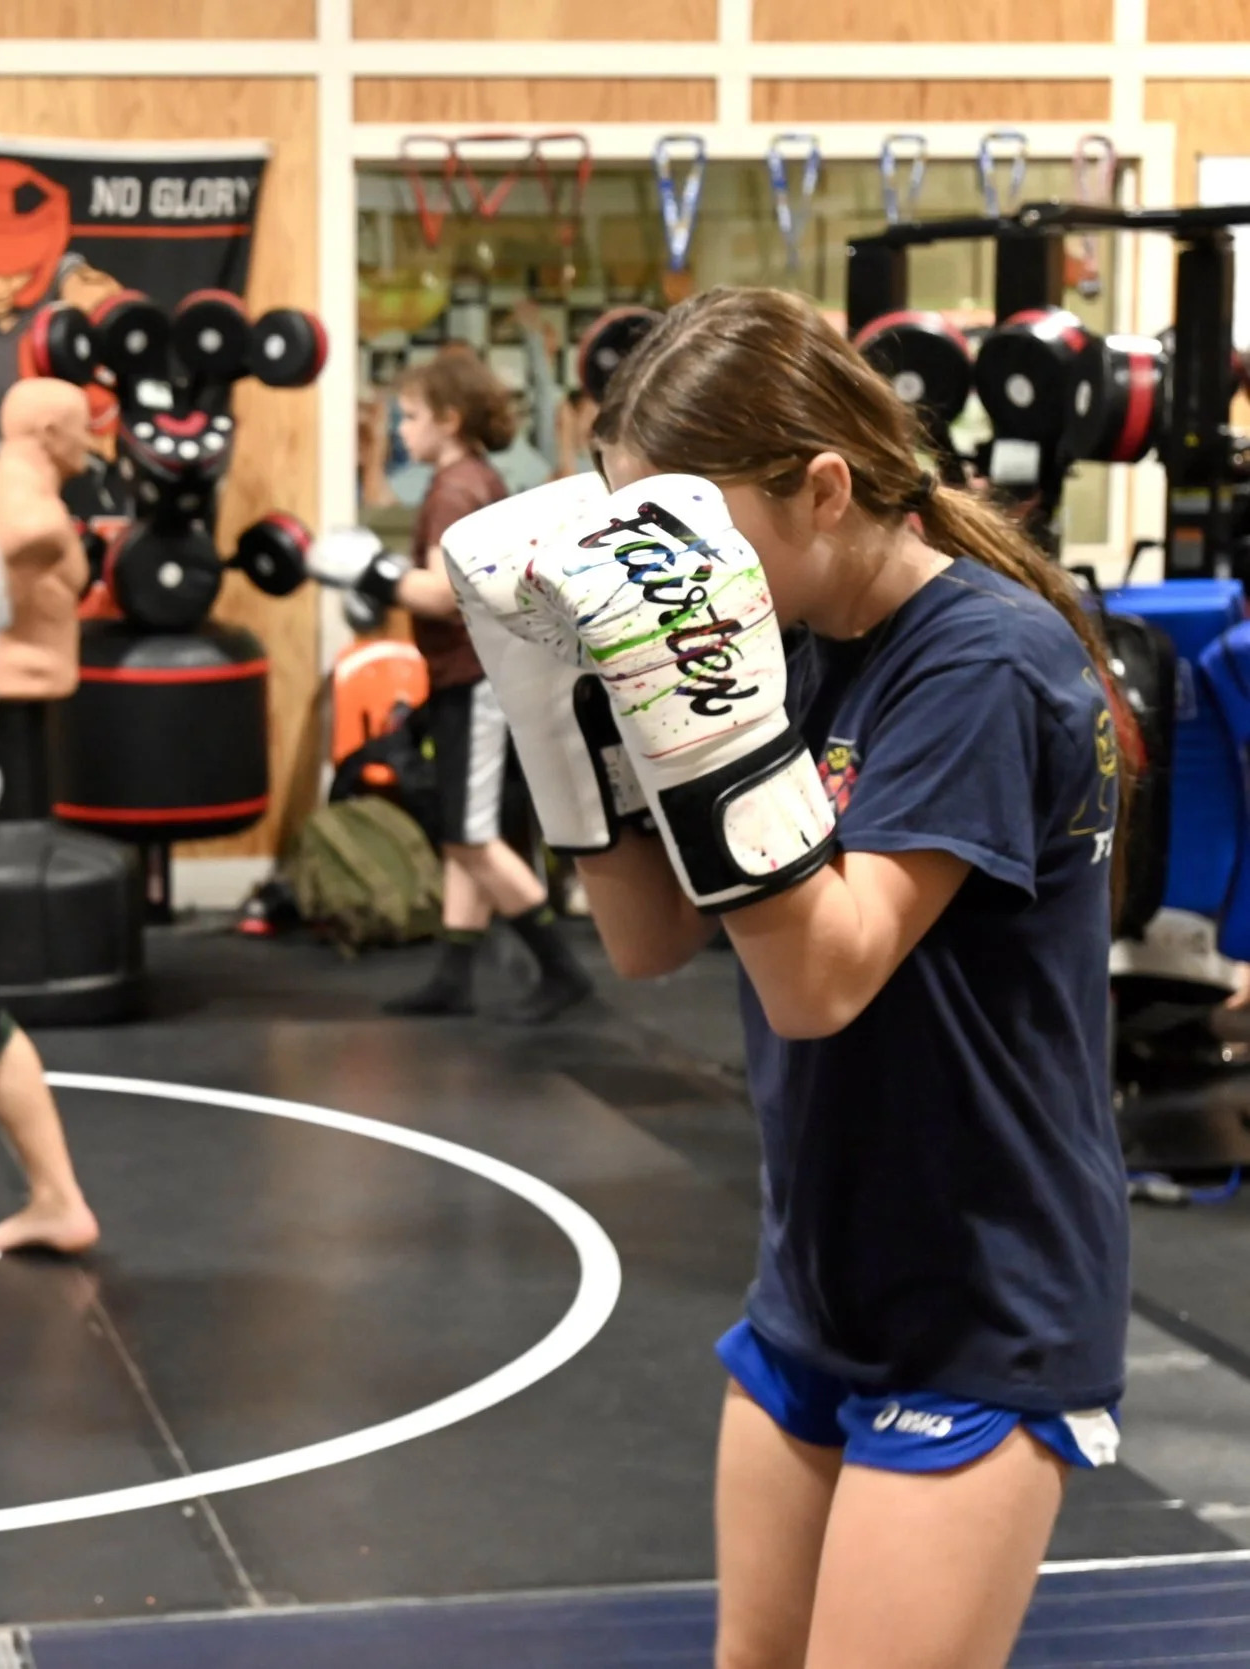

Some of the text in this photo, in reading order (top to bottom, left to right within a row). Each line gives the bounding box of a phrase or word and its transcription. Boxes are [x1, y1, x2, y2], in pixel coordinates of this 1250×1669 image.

[88, 175, 142, 217] NO
[149, 176, 254, 218] GLORY
[578, 501, 760, 717] Fairtex
